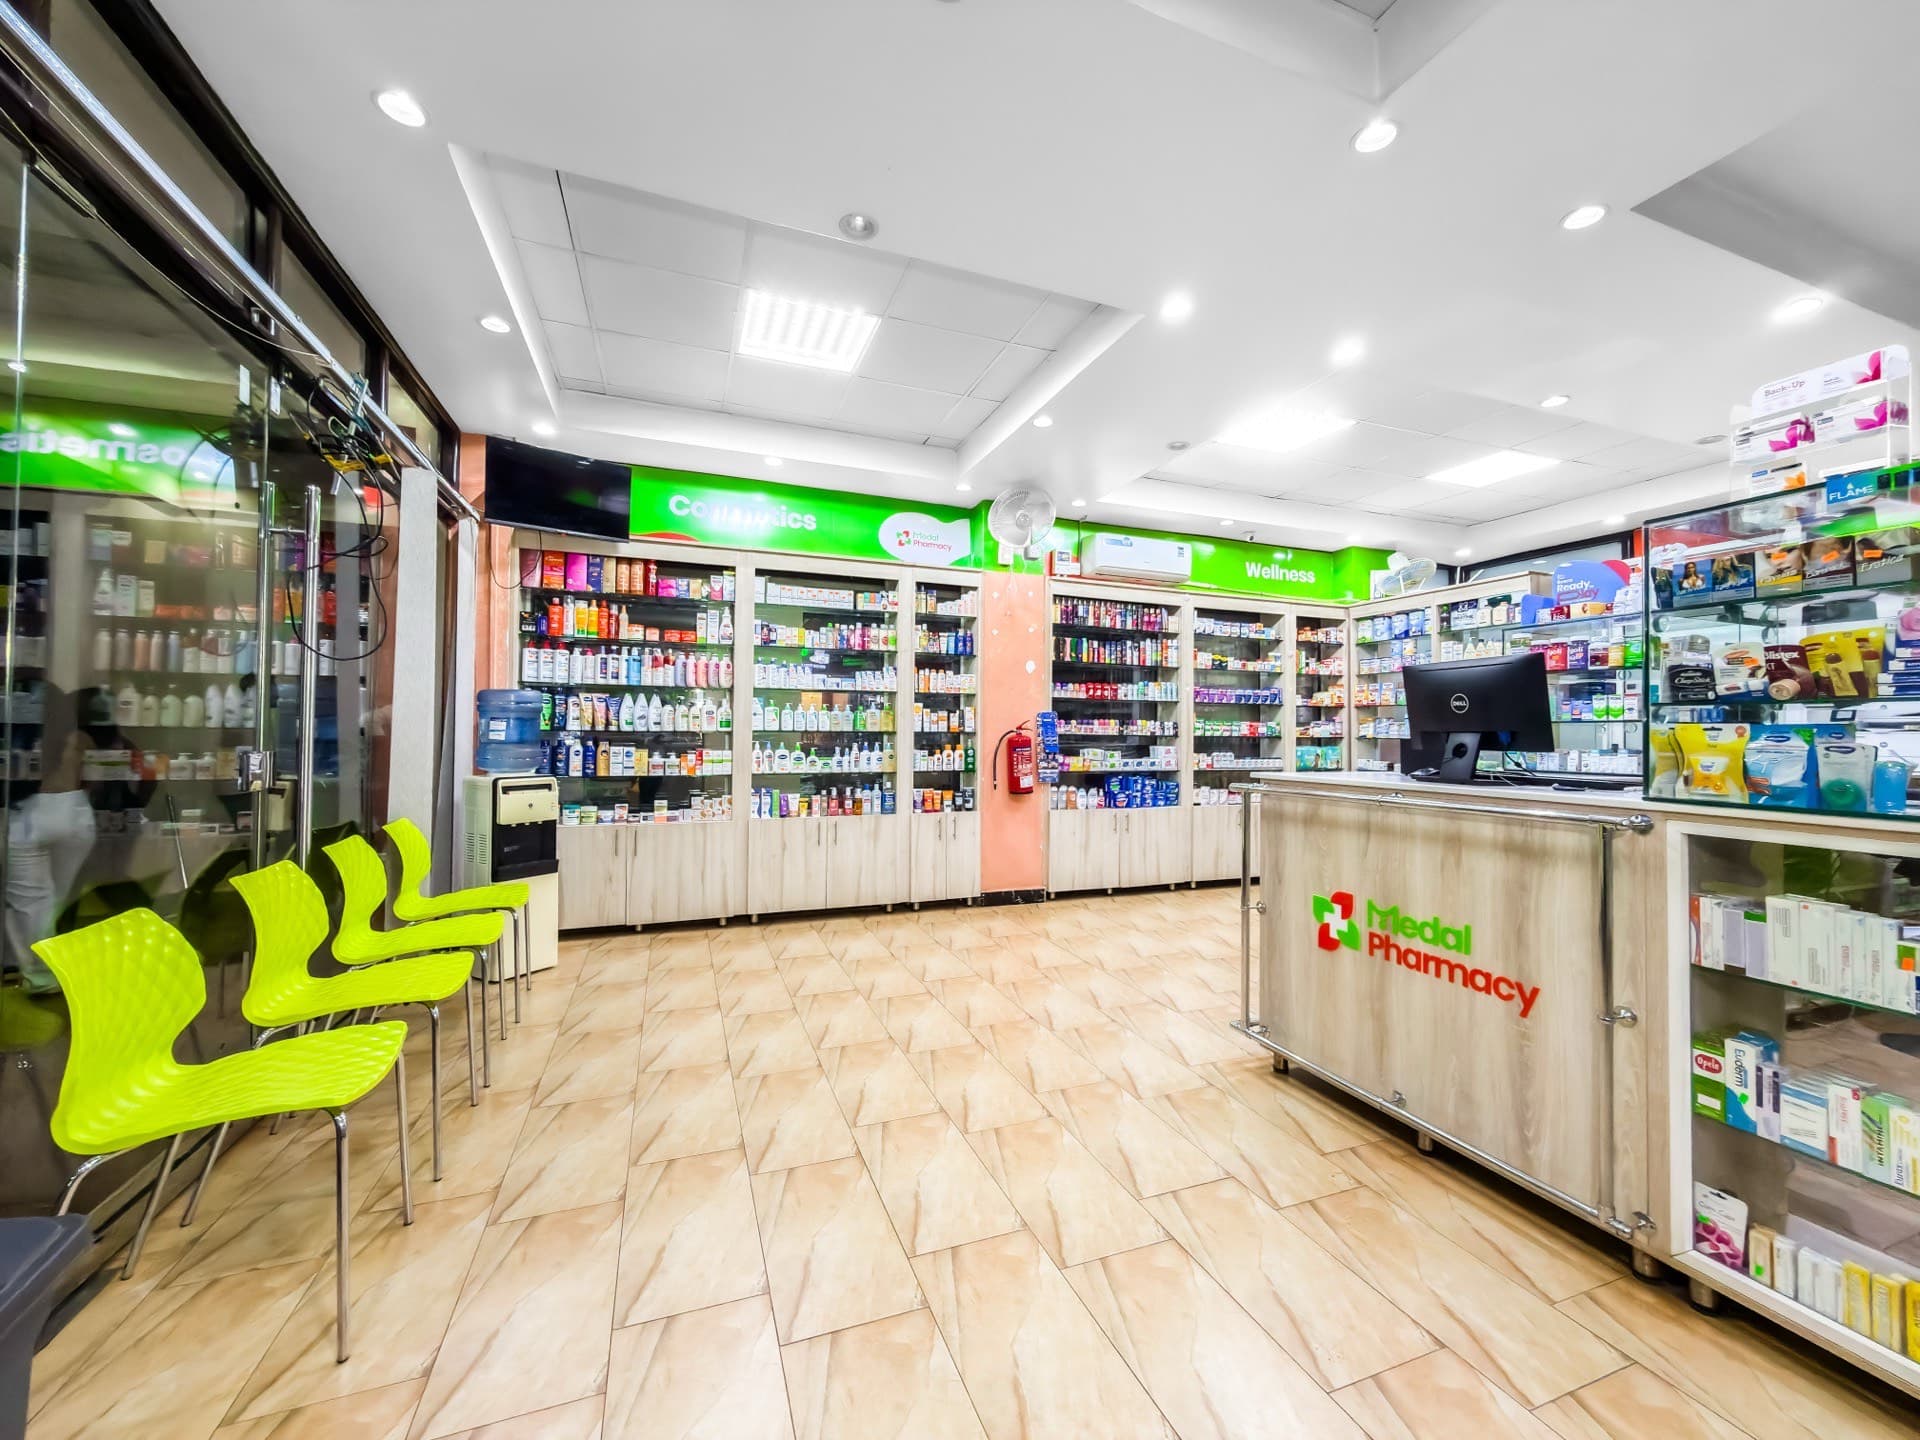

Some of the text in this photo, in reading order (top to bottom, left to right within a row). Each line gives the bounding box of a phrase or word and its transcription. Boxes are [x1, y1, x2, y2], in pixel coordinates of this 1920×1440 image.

[1829, 484, 1874, 501] FLAME
[668, 494, 817, 531] Cotics
[913, 539, 953, 552] Pharmacy
[1245, 561, 1316, 584] Wellness
[1557, 579, 1591, 592] Ready
[1366, 899, 1472, 956] Medal
[1368, 931, 1541, 1019] Pharmacy
[1735, 1048, 1746, 1088] Euderm
